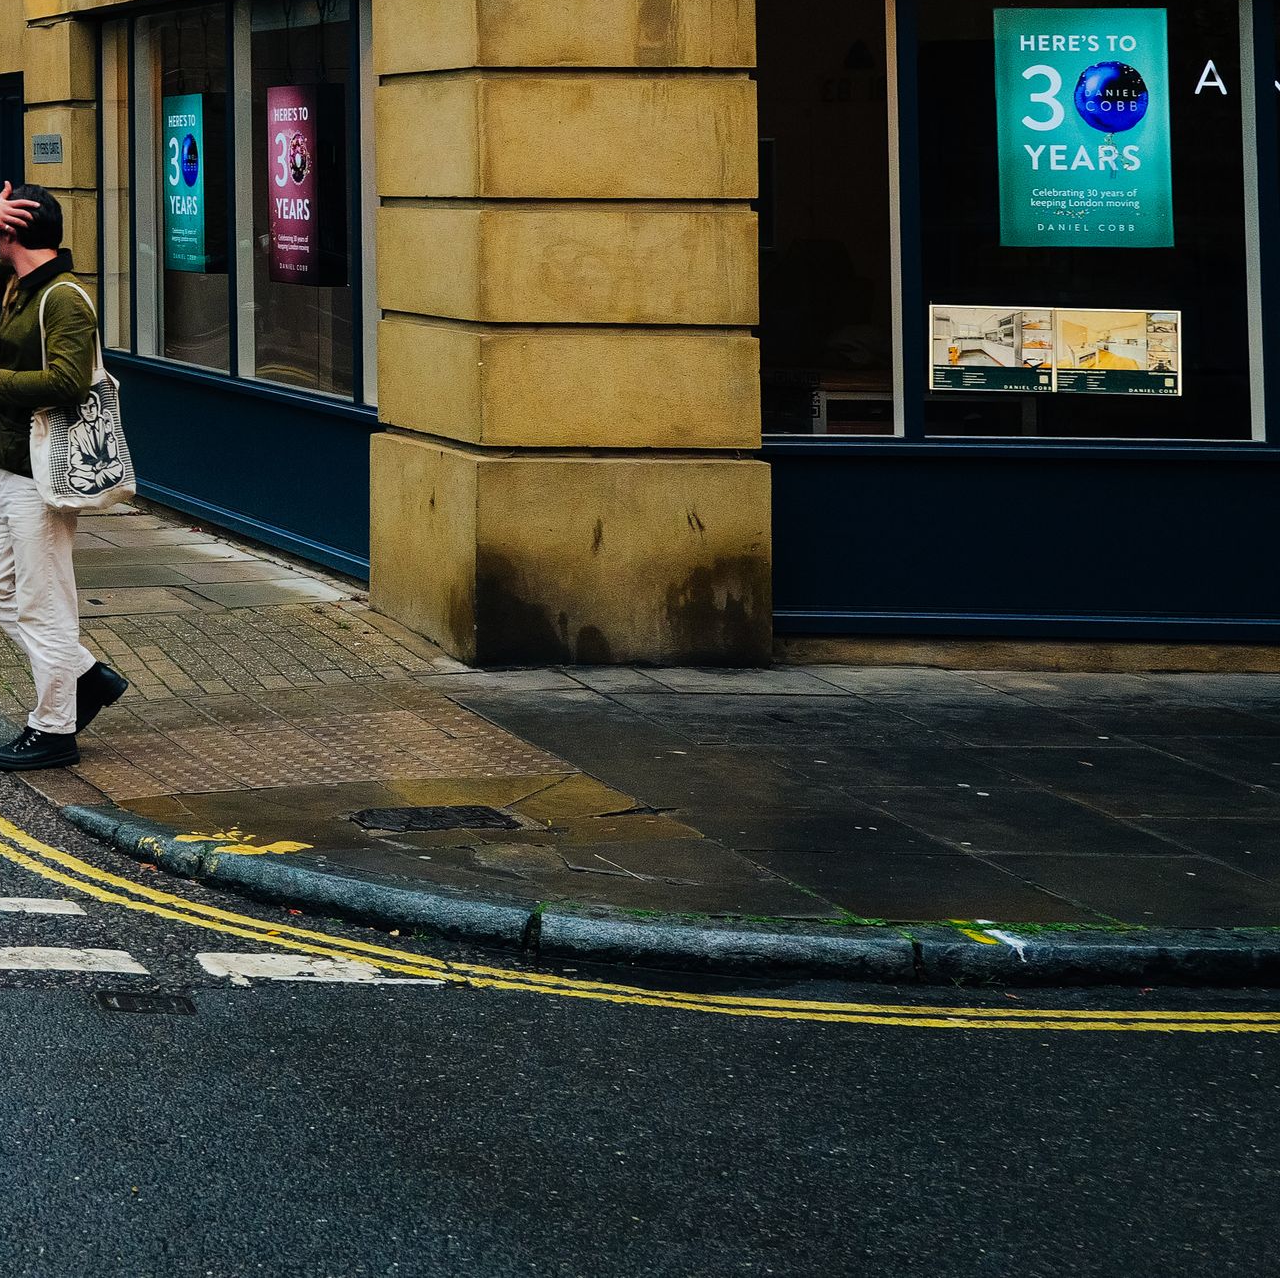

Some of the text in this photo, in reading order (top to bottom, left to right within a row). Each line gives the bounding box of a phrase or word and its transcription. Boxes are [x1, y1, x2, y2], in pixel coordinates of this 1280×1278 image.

[1020, 34, 1137, 52] HERE'S TO
[1084, 88, 1138, 98] DANIEL
[1085, 100, 1138, 112] COBB
[188, 114, 196, 126] TO
[274, 107, 309, 122] HERE'S TO
[1024, 144, 1141, 171] YEARS
[1032, 188, 1138, 199] Celebrating 30 years of
[170, 195, 198, 216] YEARS
[276, 197, 310, 221] YEARS
[1030, 198, 1140, 210] keeping London moving
[1037, 224, 1136, 232] DANIEL COBB
